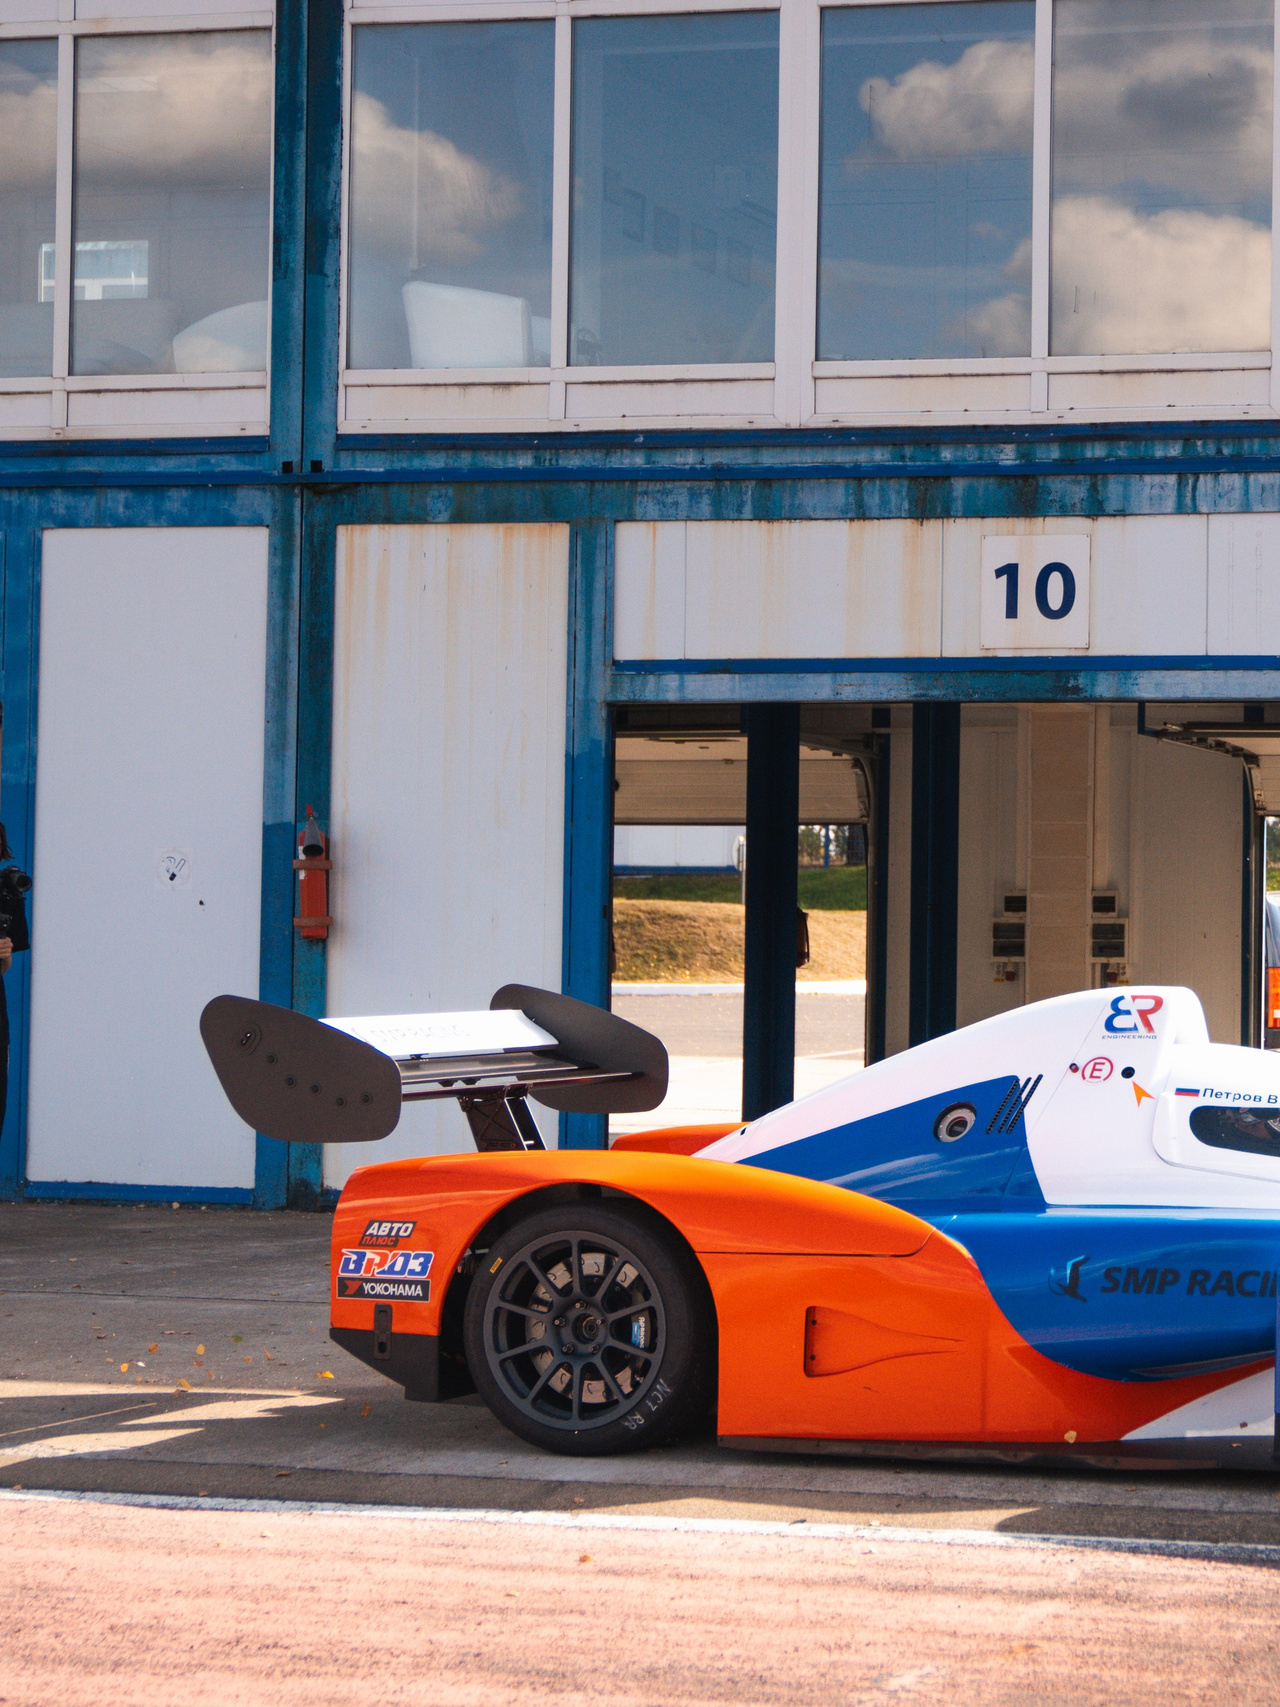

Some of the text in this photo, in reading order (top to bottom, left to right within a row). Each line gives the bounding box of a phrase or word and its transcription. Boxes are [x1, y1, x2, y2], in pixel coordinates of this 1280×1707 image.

[994, 562, 1076, 620] 10
[1089, 1062, 1105, 1079] E
[1202, 1088, 1262, 1103] Петров
[366, 1222, 414, 1236] АВТО
[362, 1237, 396, 1245] ПЛЮС
[1101, 1267, 1180, 1294] SMP
[362, 1282, 423, 1297] YOKOHAMA
